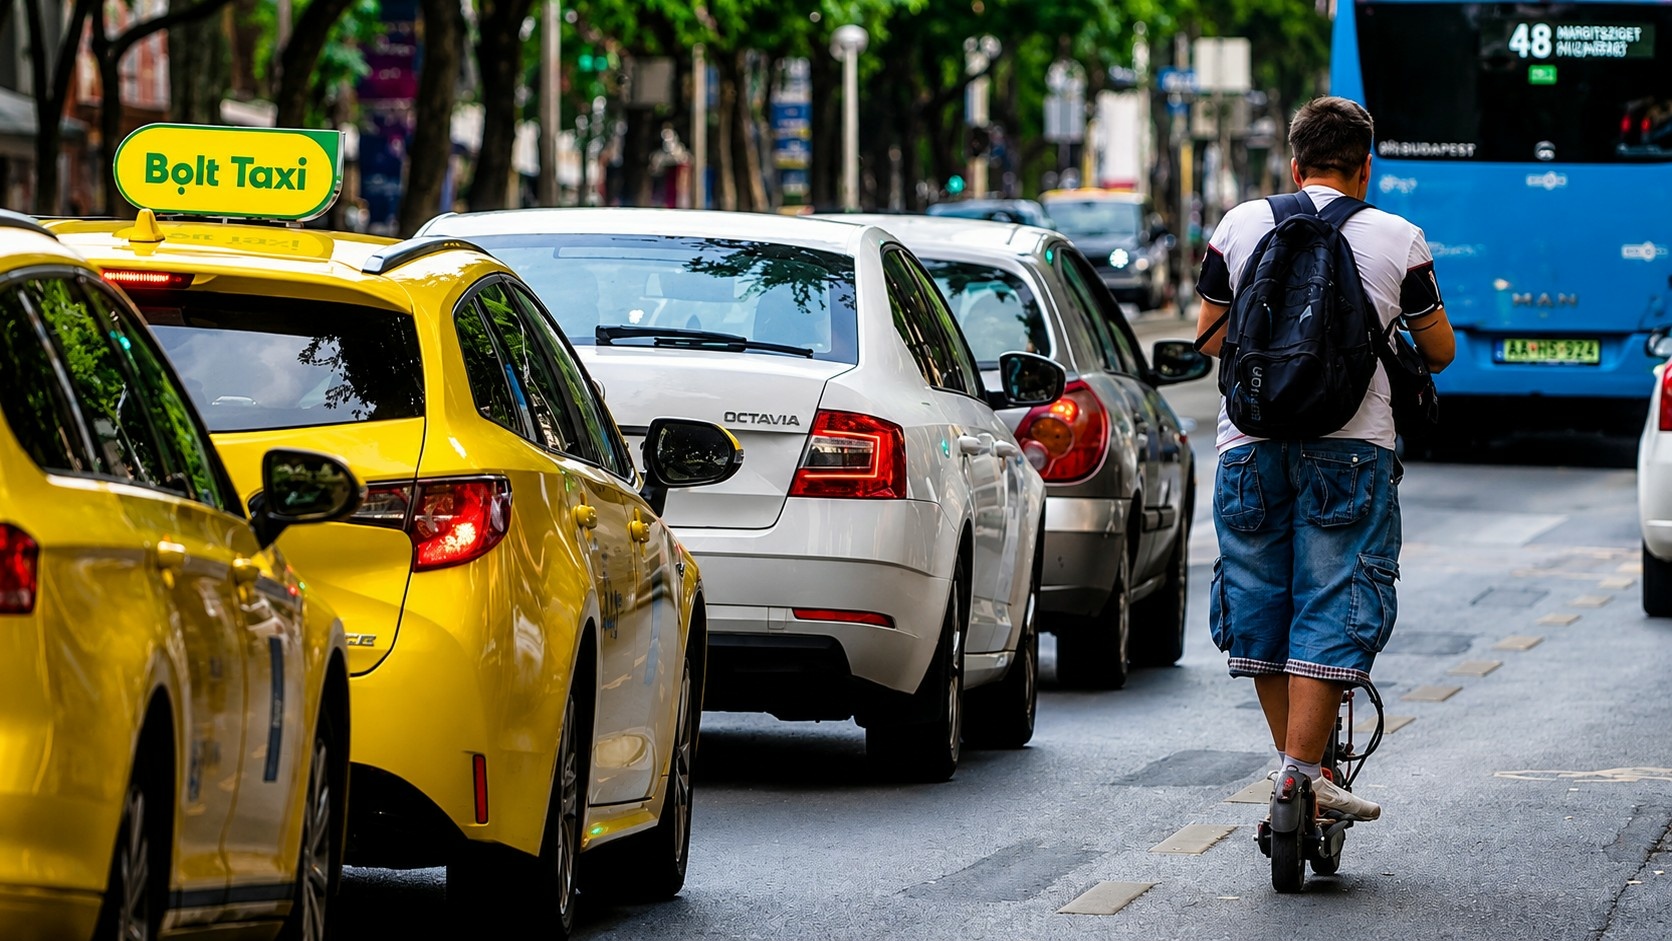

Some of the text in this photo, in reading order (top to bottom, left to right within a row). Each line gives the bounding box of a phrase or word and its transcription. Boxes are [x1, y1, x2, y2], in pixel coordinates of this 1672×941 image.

[1508, 23, 1552, 58] 48
[145, 152, 307, 195] Bolt Taxi
[724, 411, 800, 426] OCTAVIA
